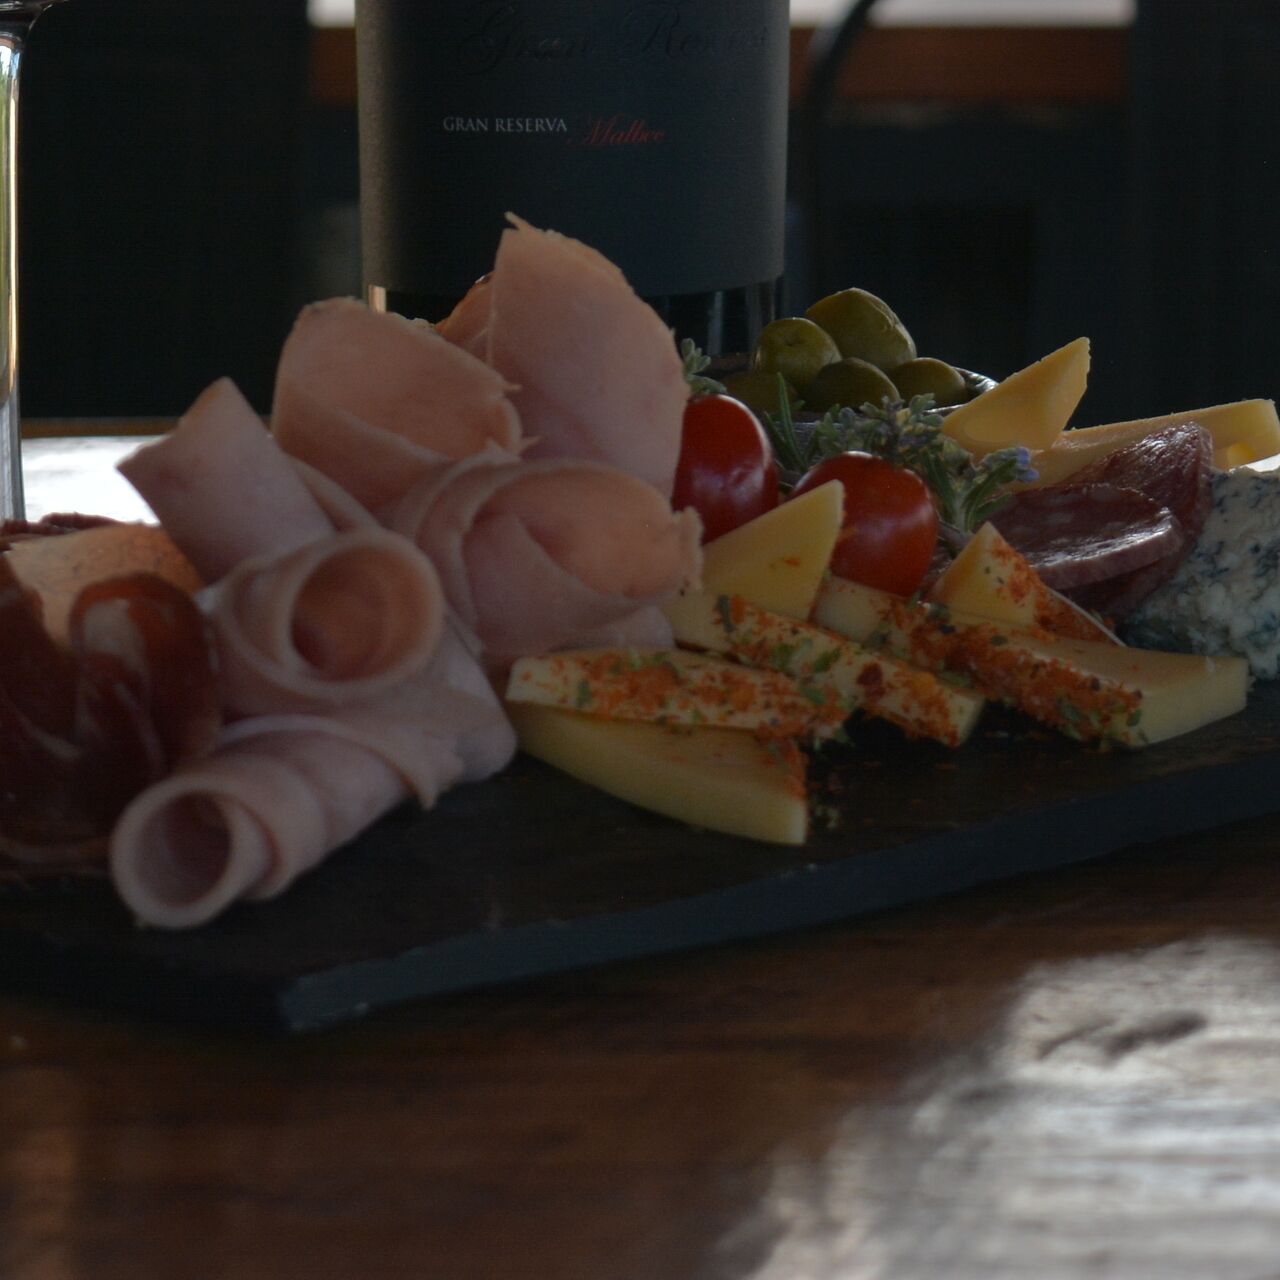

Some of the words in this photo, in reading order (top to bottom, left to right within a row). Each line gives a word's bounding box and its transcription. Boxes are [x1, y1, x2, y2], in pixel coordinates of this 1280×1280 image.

[443, 117, 488, 132] GRAN
[495, 117, 568, 132] RESERVA
[568, 115, 665, 145] Malbec
